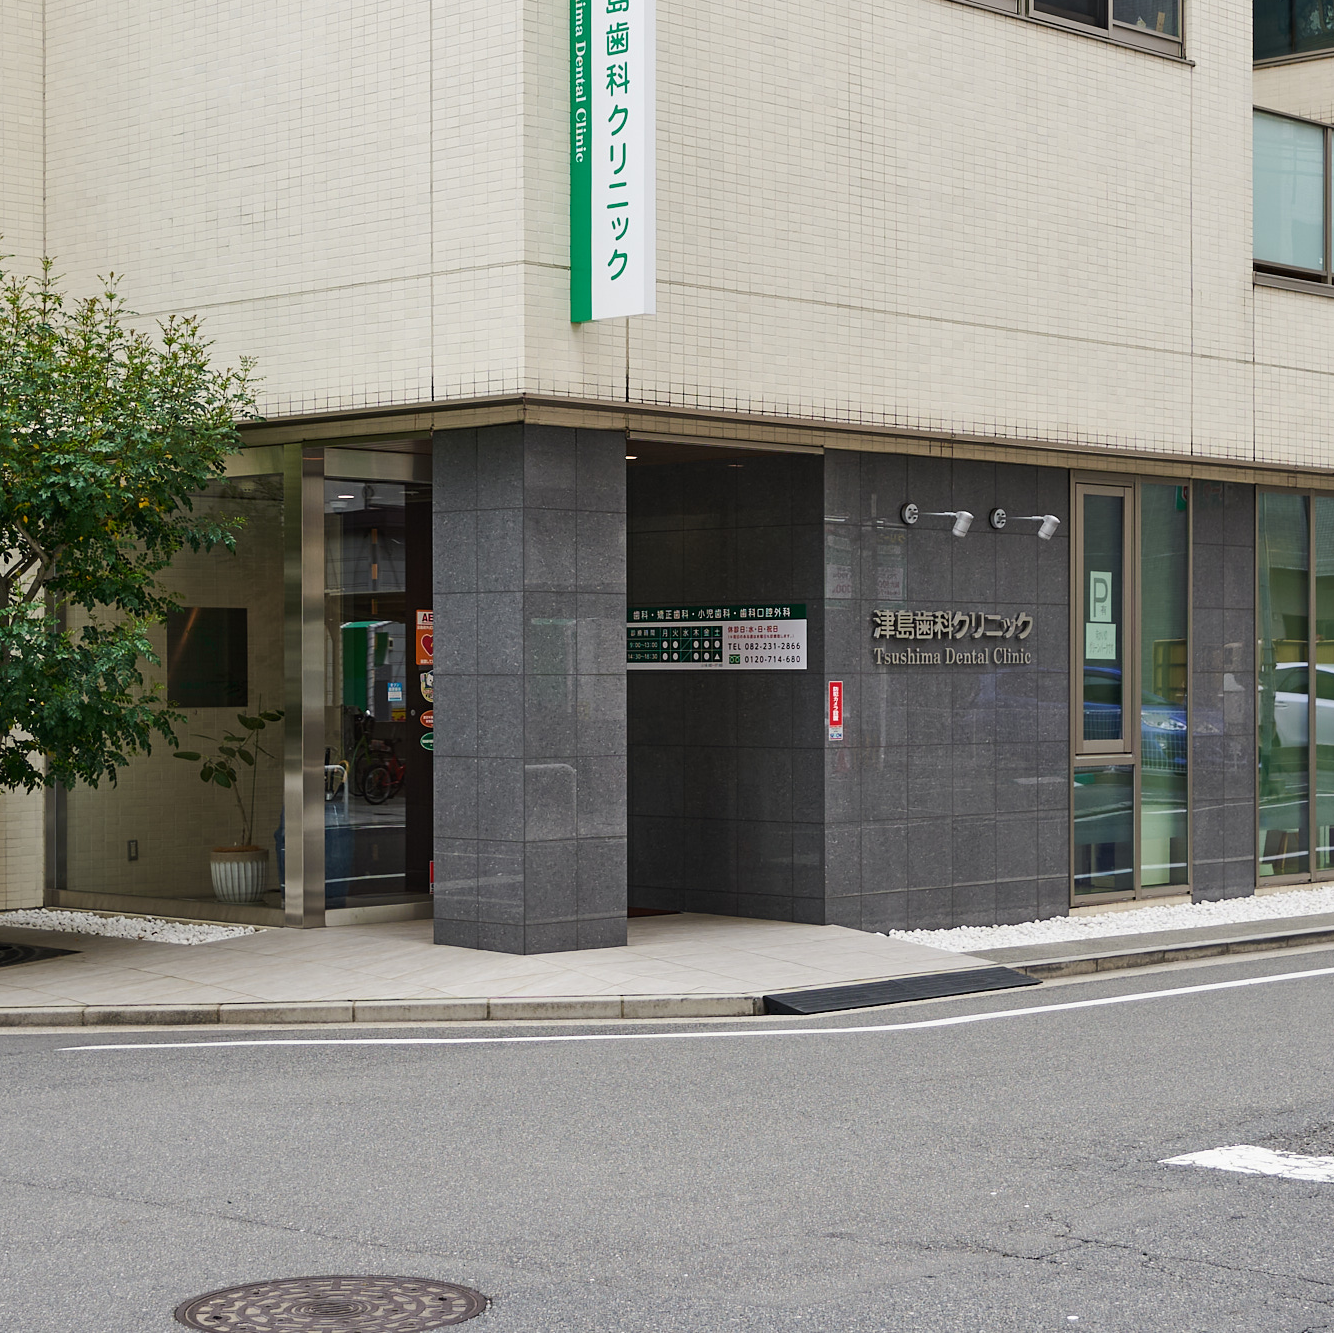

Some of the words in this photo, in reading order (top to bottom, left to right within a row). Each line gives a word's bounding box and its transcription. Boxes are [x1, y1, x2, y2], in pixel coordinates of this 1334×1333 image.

[575, 40, 587, 103] Dental
[575, 107, 587, 163] Clinic
[1093, 577, 1108, 618] P
[662, 629, 668, 637] 月
[672, 629, 679, 637] 火
[873, 609, 1034, 640] 津島歯科クリニック
[728, 643, 741, 651] TEL
[744, 642, 801, 651] 082-231-2866
[873, 647, 941, 665] Tsushima
[945, 647, 989, 665] Dental
[993, 647, 1032, 665] Clinic
[744, 655, 801, 664] 0120-714-680
